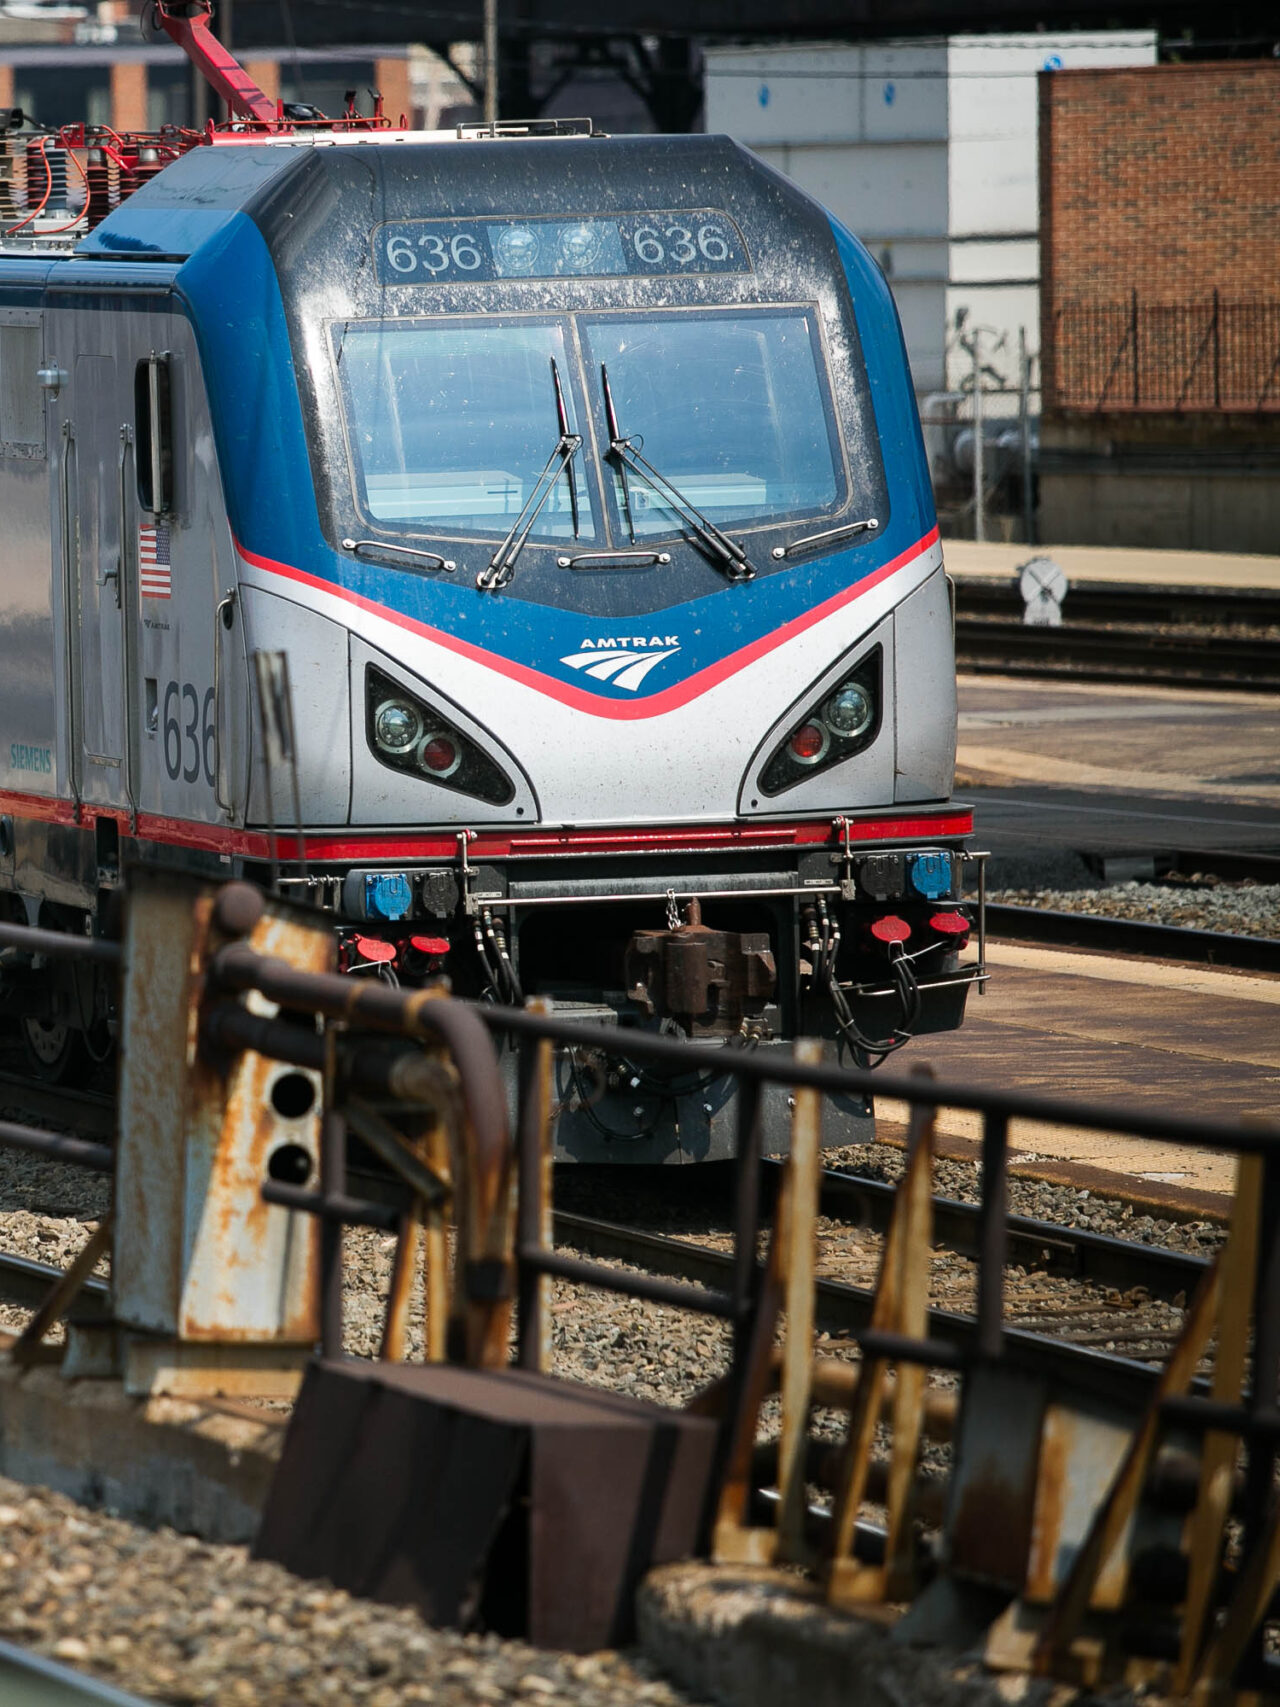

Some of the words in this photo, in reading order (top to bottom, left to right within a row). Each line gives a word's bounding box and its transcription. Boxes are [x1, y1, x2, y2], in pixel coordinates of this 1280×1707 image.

[386, 233, 482, 273] 636
[632, 225, 729, 264] 636
[580, 635, 680, 649] AMTRAK
[164, 681, 216, 788] 636
[10, 743, 52, 774] SIEMENS
